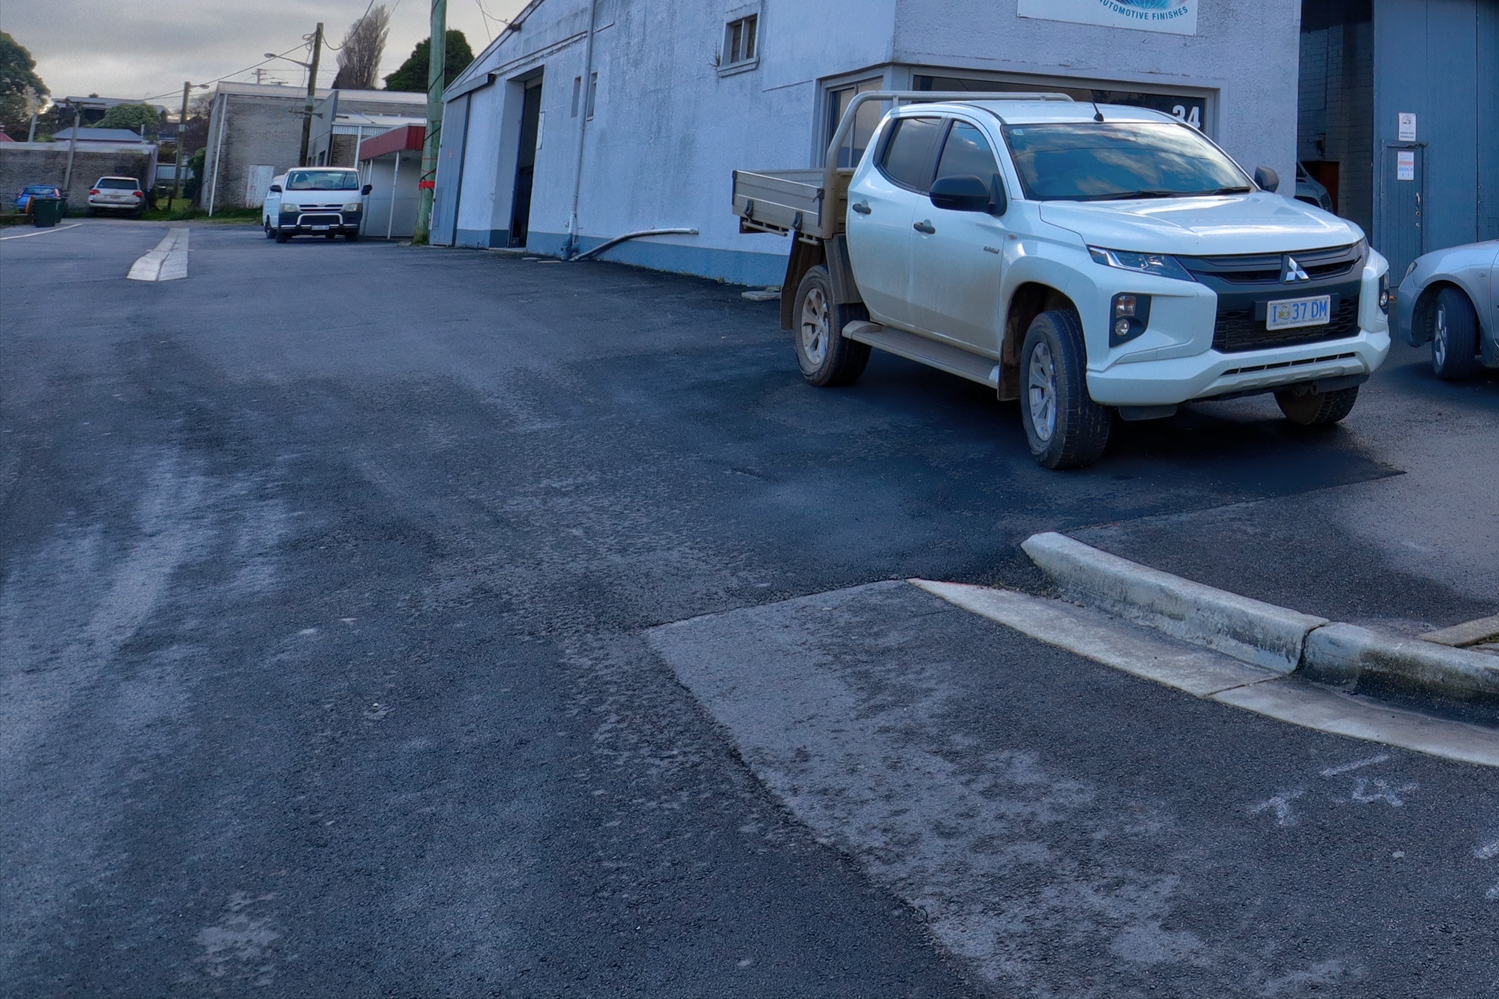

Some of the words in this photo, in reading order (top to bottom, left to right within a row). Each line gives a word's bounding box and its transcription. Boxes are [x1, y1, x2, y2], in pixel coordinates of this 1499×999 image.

[1152, 5, 1188, 21] FINISHES
[1172, 104, 1201, 129] 34
[1292, 302, 1307, 321] 37
[1311, 301, 1327, 319] DM
